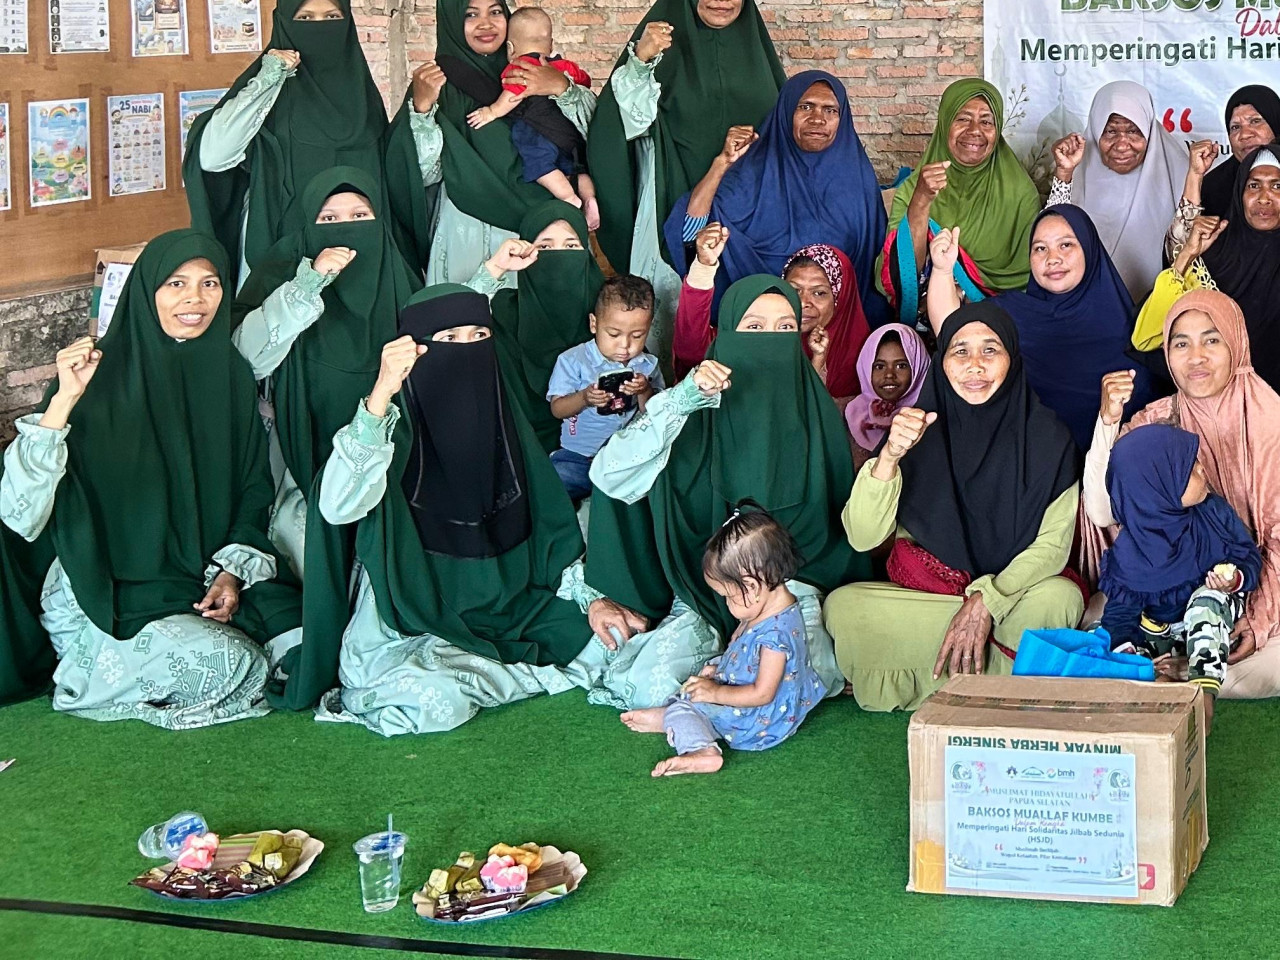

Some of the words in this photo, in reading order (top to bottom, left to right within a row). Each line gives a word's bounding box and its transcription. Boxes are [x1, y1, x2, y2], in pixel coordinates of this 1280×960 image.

[1021, 36, 1216, 67] Memperingati
[119, 100, 131, 110] 25
[131, 105, 151, 114] NABI
[948, 736, 1006, 748] SINERGI
[1010, 739, 1059, 751] HERBA
[1064, 742, 1121, 754] MINYAK
[1058, 769, 1075, 777] bmh
[1009, 797, 1035, 805] PAPUA
[968, 806, 1011, 818] BAKSOS
[1014, 809, 1068, 821] MUALLAF
[1072, 812, 1113, 823] KUMBE
[957, 822, 1009, 834] Memperingati
[1011, 824, 1027, 833] Hari
[1029, 825, 1068, 836] Solidaritas
[1070, 828, 1092, 837] Jilbab
[1094, 829, 1125, 838] Sedunia
[1027, 835, 1054, 845] (HSJD)
